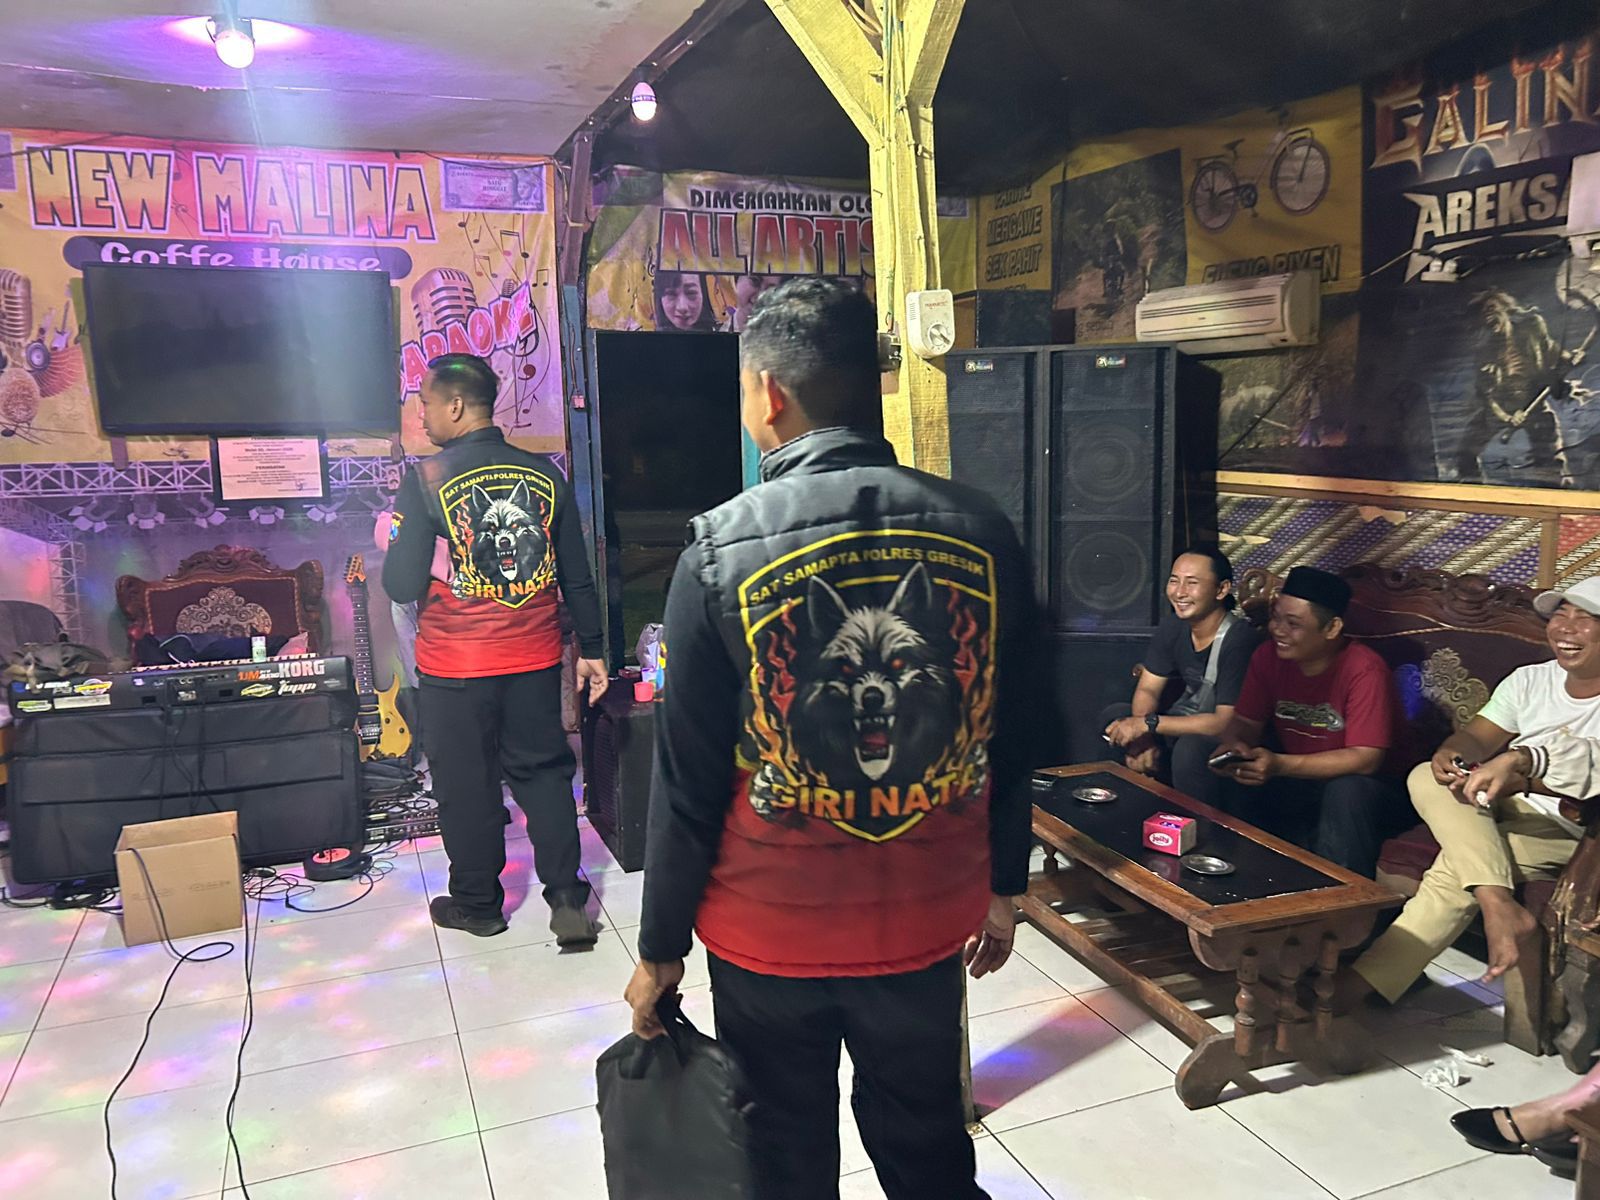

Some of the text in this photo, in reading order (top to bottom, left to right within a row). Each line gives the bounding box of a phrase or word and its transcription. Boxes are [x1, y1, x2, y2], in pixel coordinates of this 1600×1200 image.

[26, 146, 435, 240] NEW MALINA
[690, 189, 831, 212] DIMERIAHKAN
[100, 241, 234, 267] Coffe
[657, 208, 748, 275] ALL
[445, 486, 459, 499] SAT
[460, 474, 493, 490] SAMAPTA
[494, 472, 523, 481] POLRES
[462, 581, 503, 599] SIRI
[750, 579, 780, 605] SAT
[783, 552, 860, 586] SAMAPTA
[926, 550, 985, 576] GRESIK
[278, 659, 325, 678] KORG
[770, 783, 856, 820] SIRI
